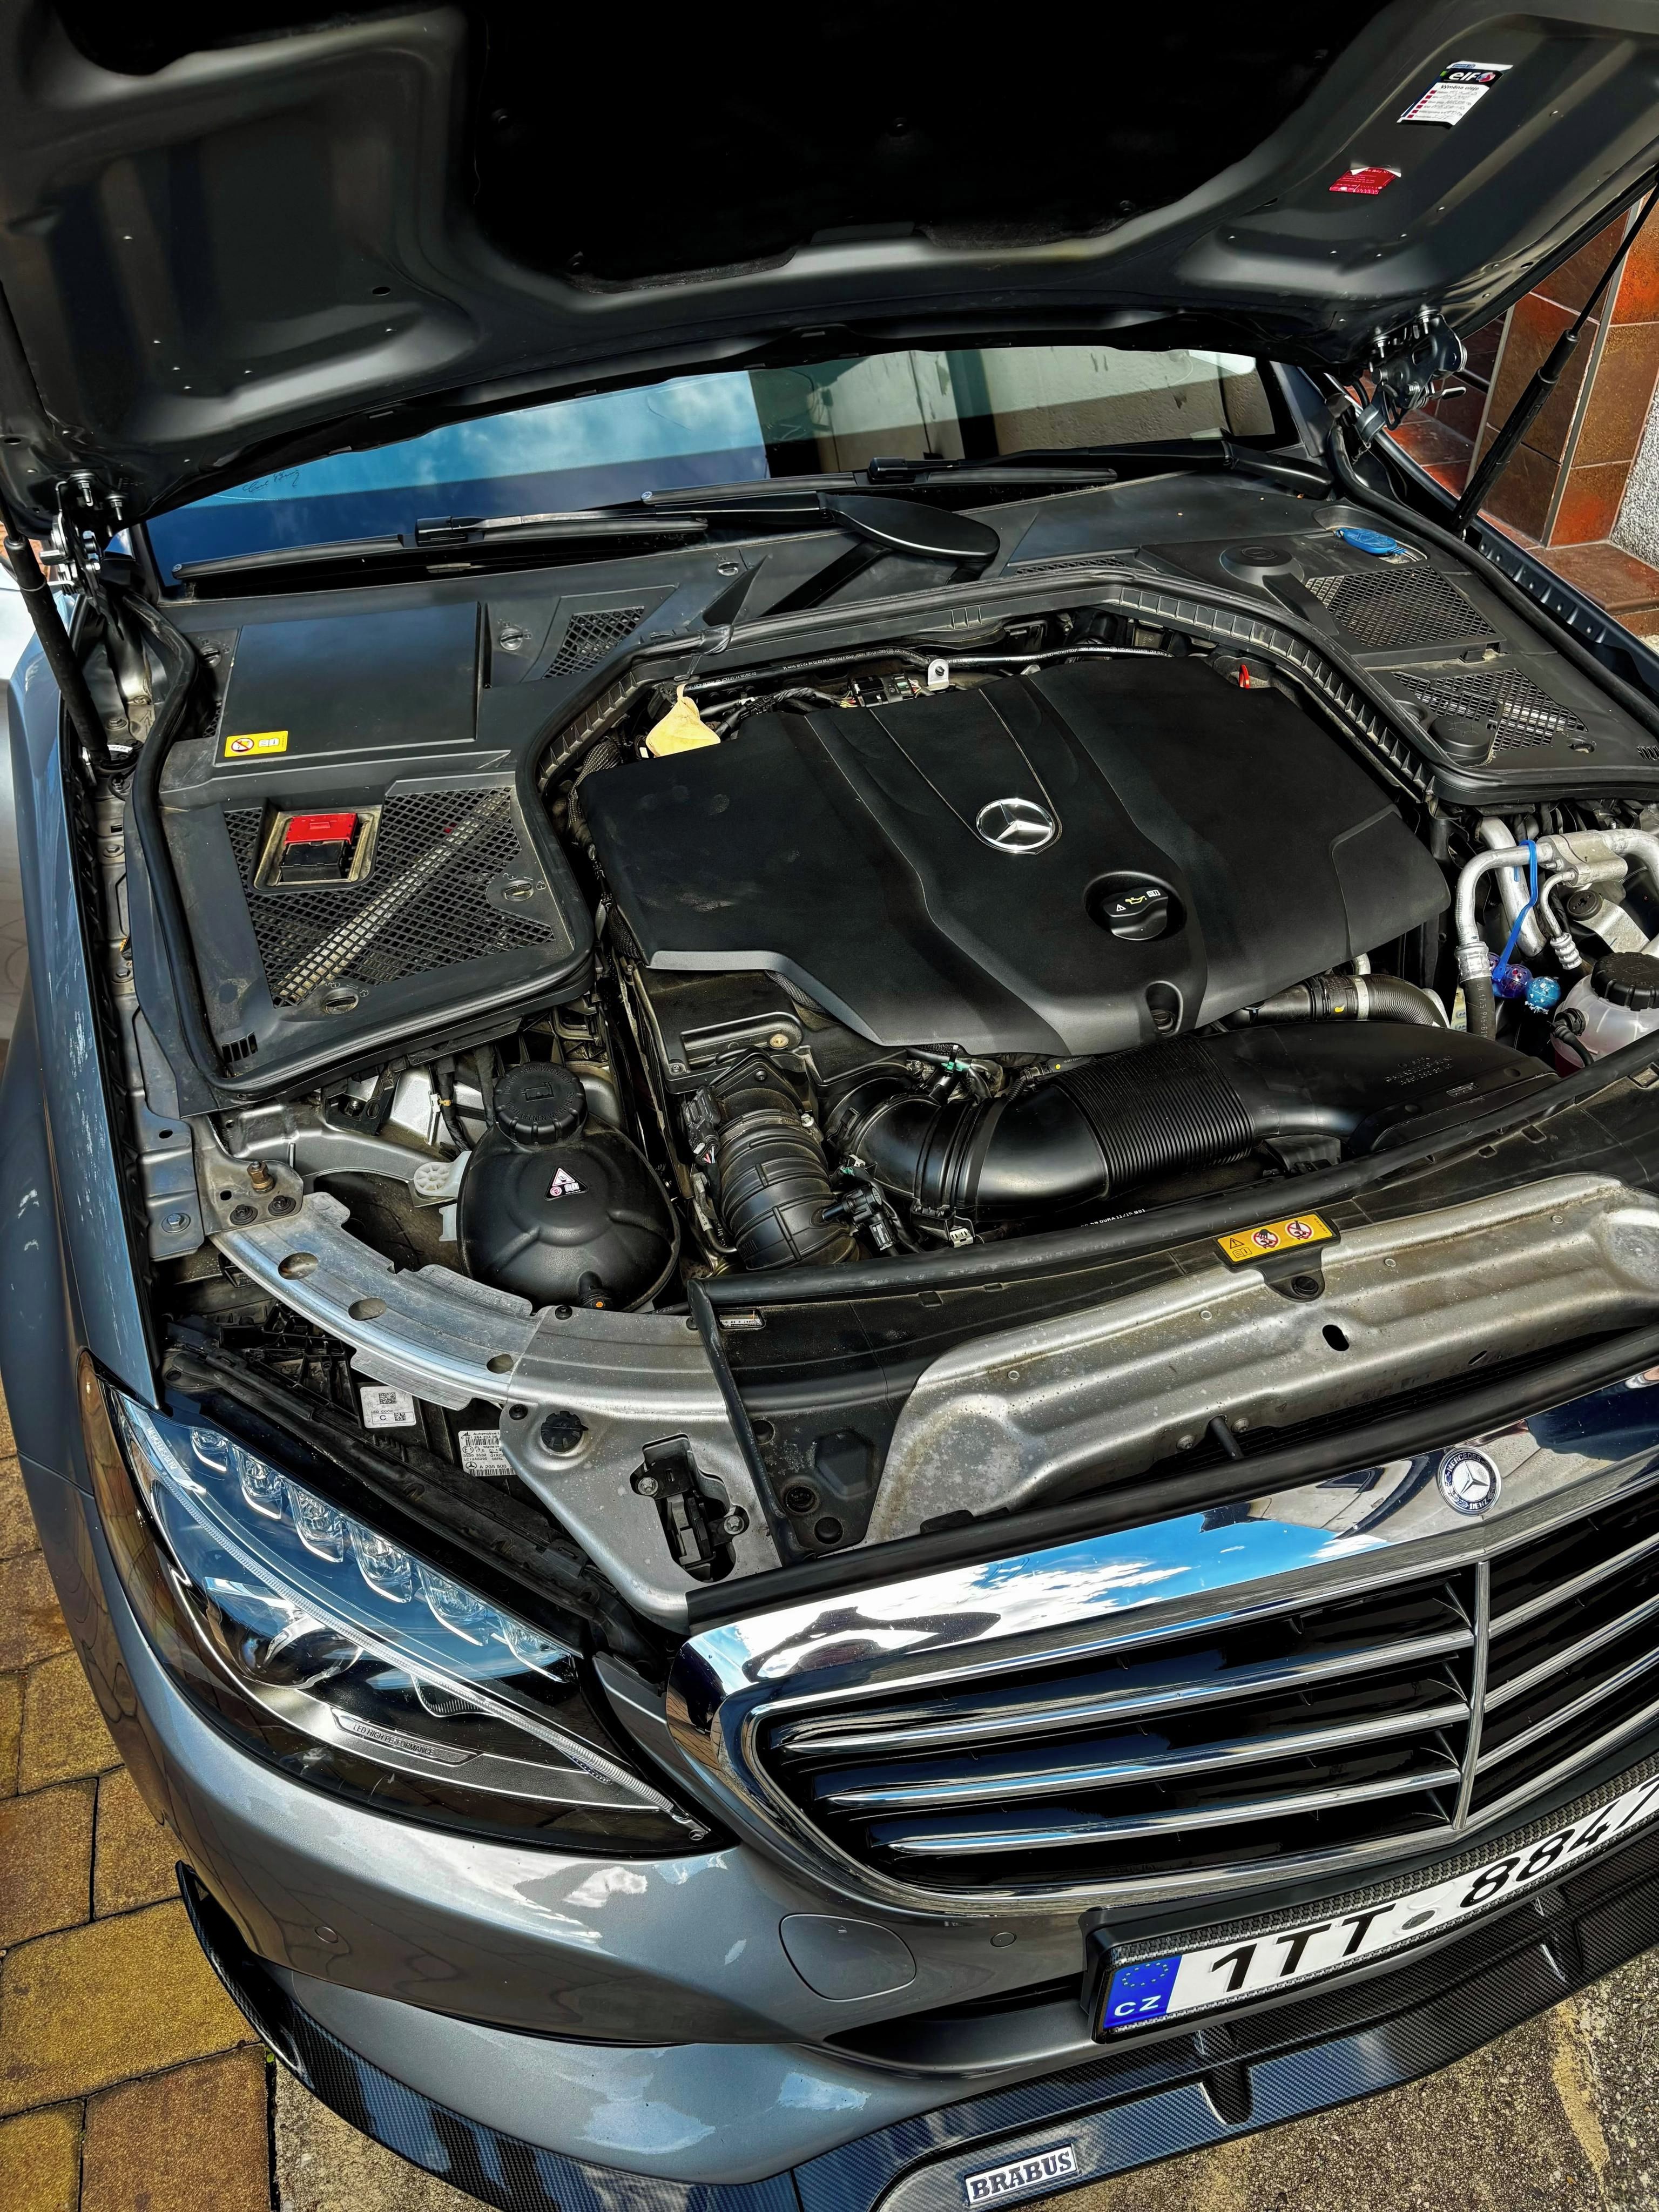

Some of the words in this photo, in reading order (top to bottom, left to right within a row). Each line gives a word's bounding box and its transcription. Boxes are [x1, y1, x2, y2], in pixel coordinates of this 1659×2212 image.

[1448, 72, 1481, 81] elf
[1447, 1453, 1481, 1472] MERCEDES
[1469, 1500, 1488, 1509] BENZ
[353, 1724, 367, 1734] LED
[367, 1728, 384, 1739] HIGH
[386, 1735, 434, 1755] PERFORMANCE
[1211, 1903, 1396, 1992] 1TT
[1460, 1775, 1659, 1908] 8847
[1114, 1995, 1161, 2016] CZ
[970, 2151, 1071, 2199] BRABUS
